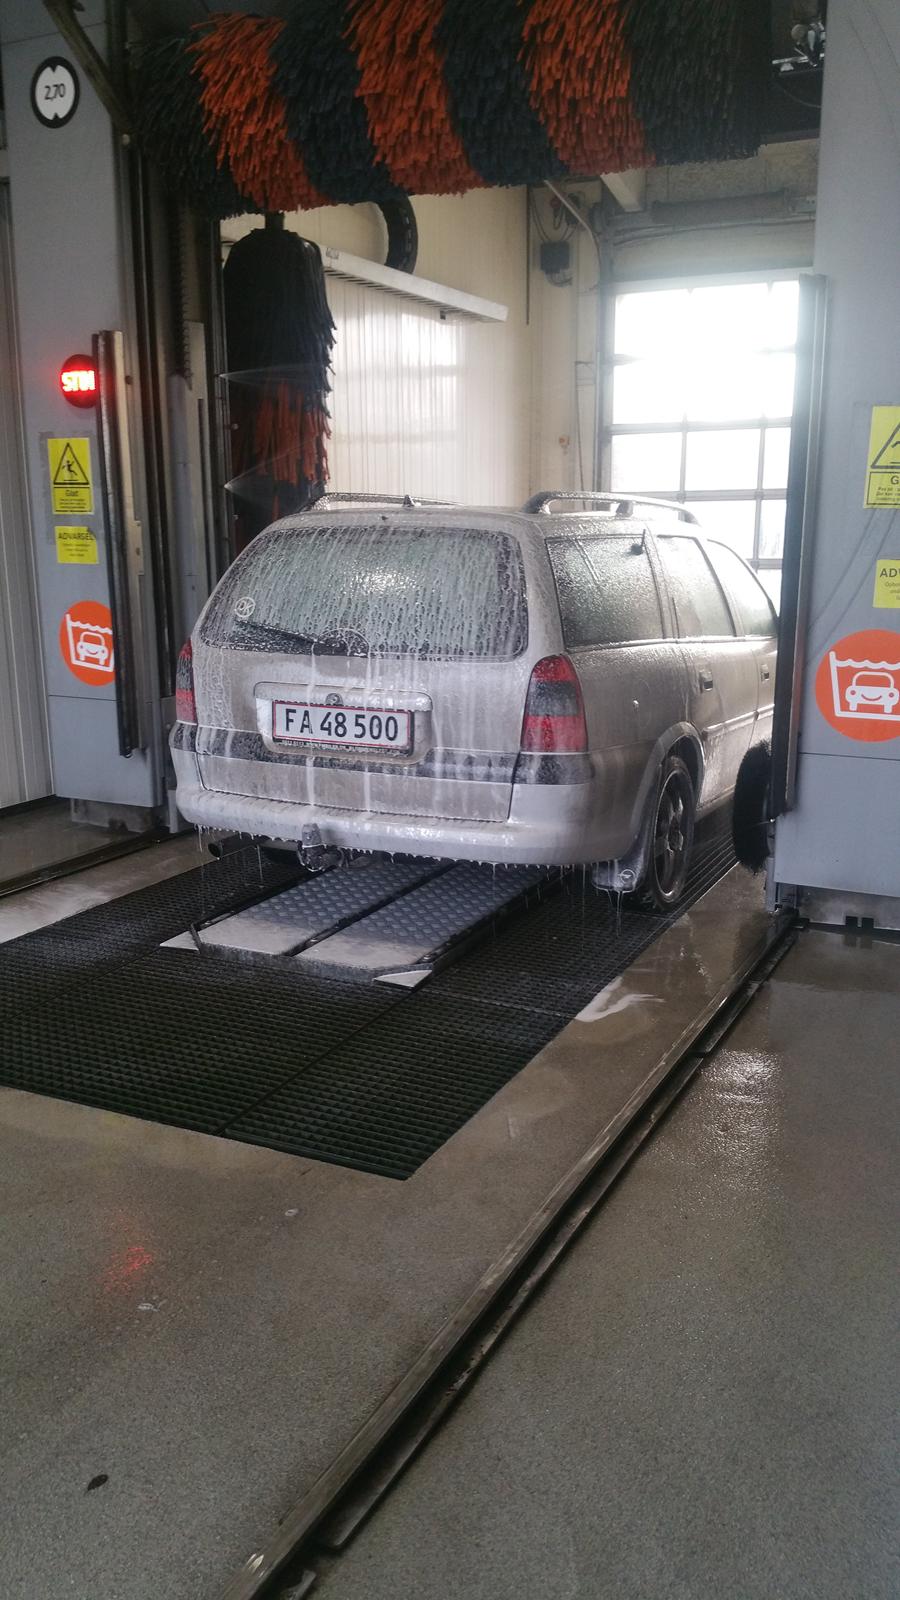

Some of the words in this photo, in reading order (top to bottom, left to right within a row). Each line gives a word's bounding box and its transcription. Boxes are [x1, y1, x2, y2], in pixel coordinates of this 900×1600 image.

[880, 568, 900, 578] AD
[285, 708, 313, 734] FA
[320, 711, 348, 738] 48
[354, 714, 399, 741] 500
